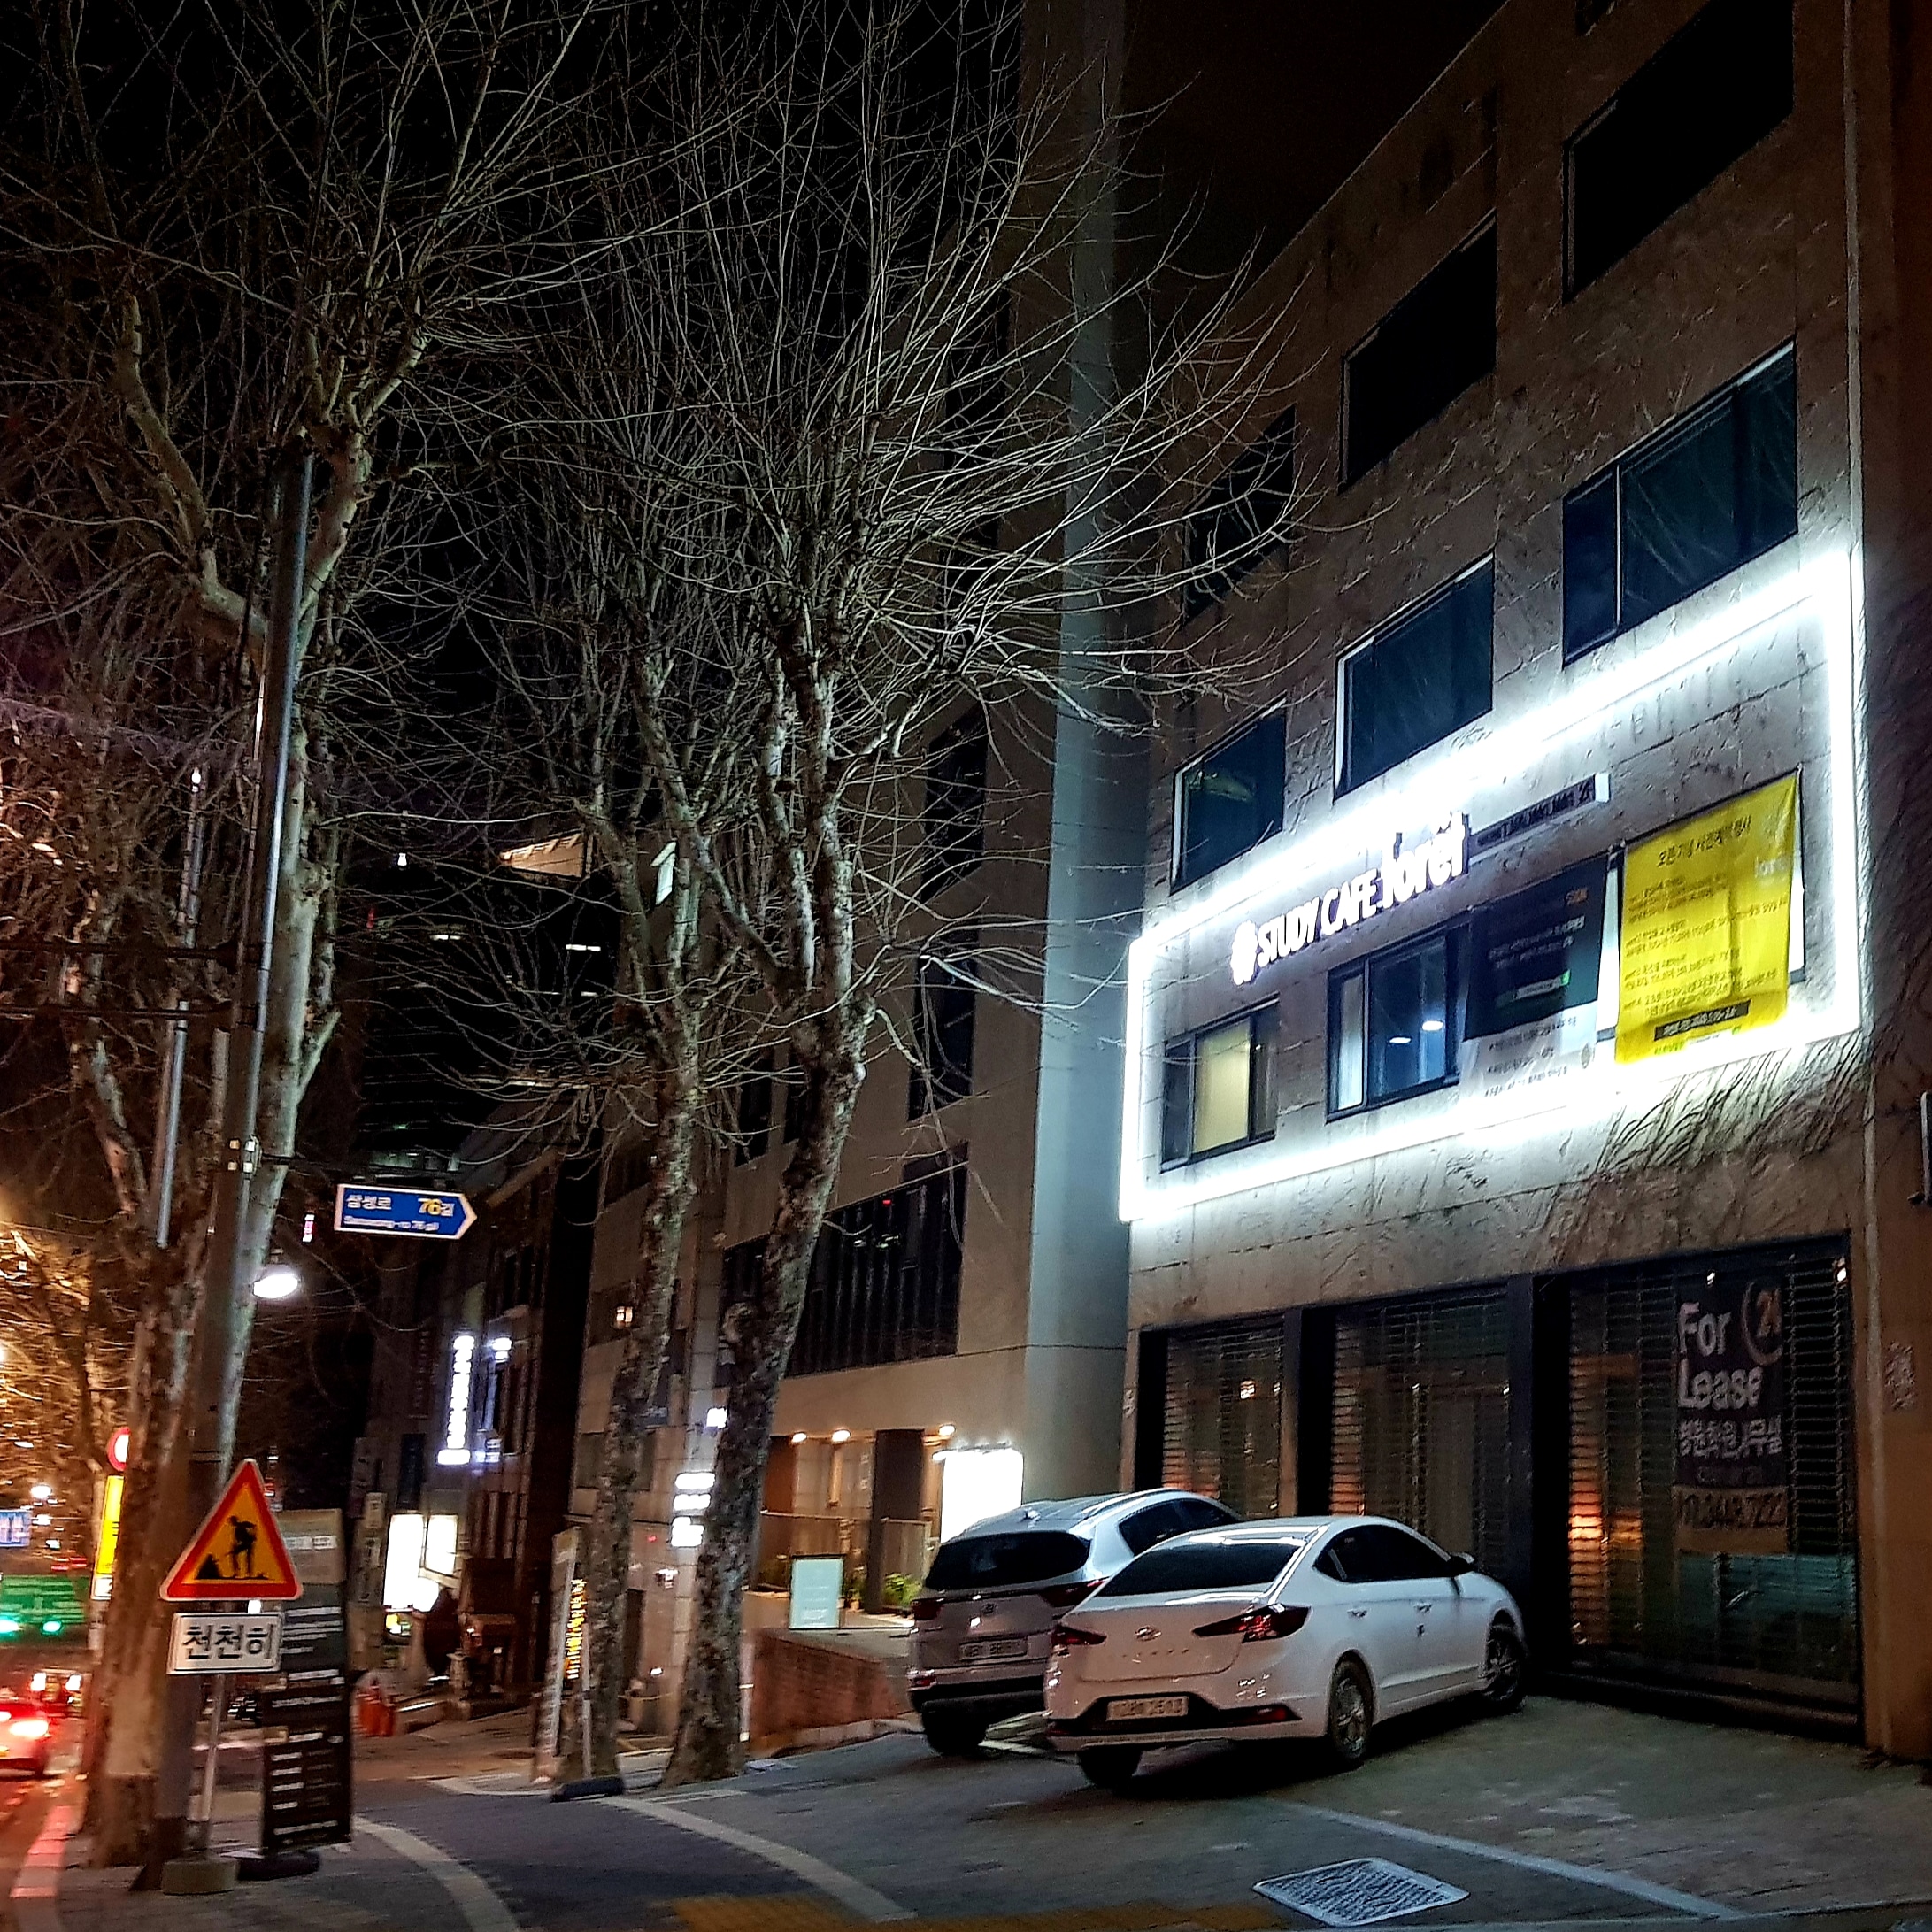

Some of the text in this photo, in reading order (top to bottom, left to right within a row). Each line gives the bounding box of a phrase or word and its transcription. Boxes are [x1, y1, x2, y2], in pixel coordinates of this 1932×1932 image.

[1257, 896, 1320, 968] STUDY
[345, 1194, 456, 1218] 삼성로 76길
[1678, 1301, 1732, 1357] For
[1678, 1359, 1765, 1411] Lease
[182, 1623, 276, 1660] 천천히
